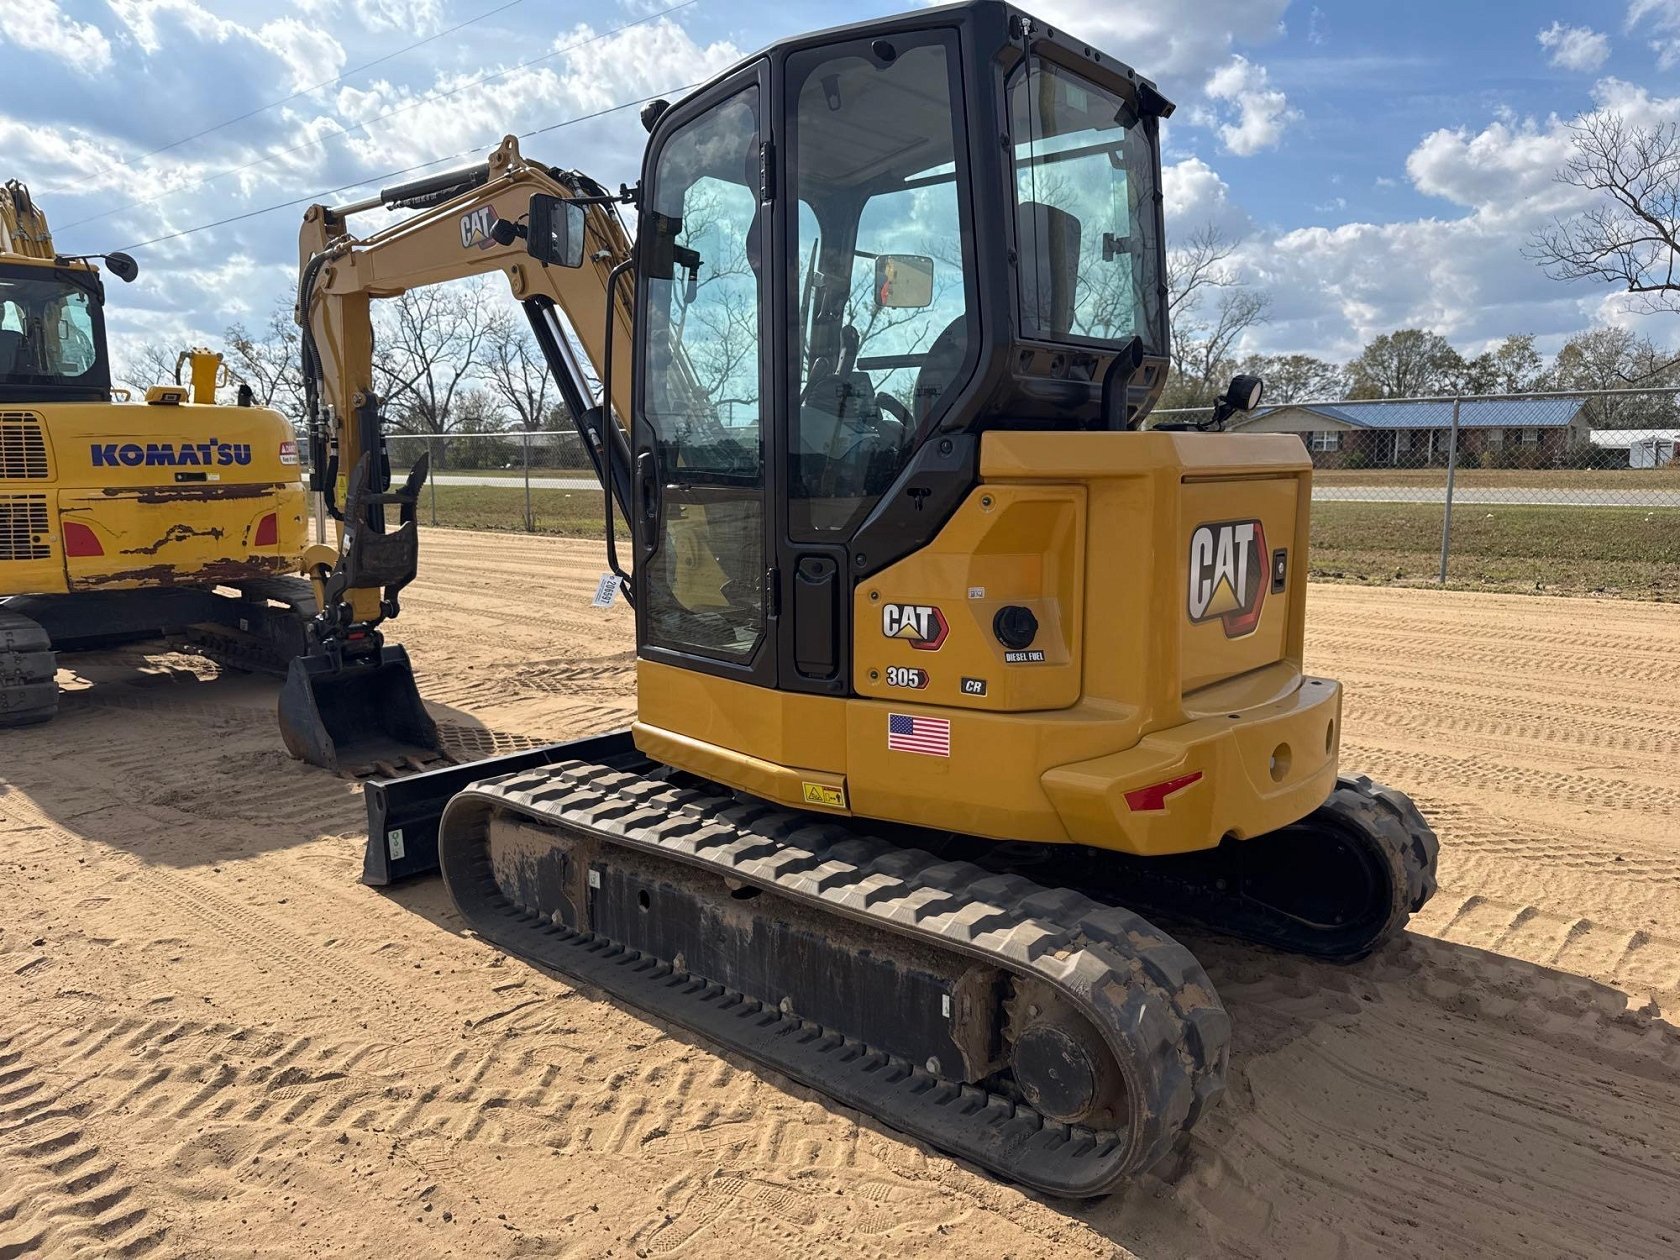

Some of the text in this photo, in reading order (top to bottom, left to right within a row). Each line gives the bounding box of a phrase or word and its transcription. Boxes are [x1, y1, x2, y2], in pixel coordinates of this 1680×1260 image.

[460, 205, 490, 248] CAT
[90, 437, 252, 467] KOMATSU
[1188, 523, 1255, 619] CAT
[883, 604, 933, 640] CAT
[1005, 651, 1044, 662] DIESEL FUEL
[887, 666, 919, 688] 305
[965, 680, 982, 693] CR
